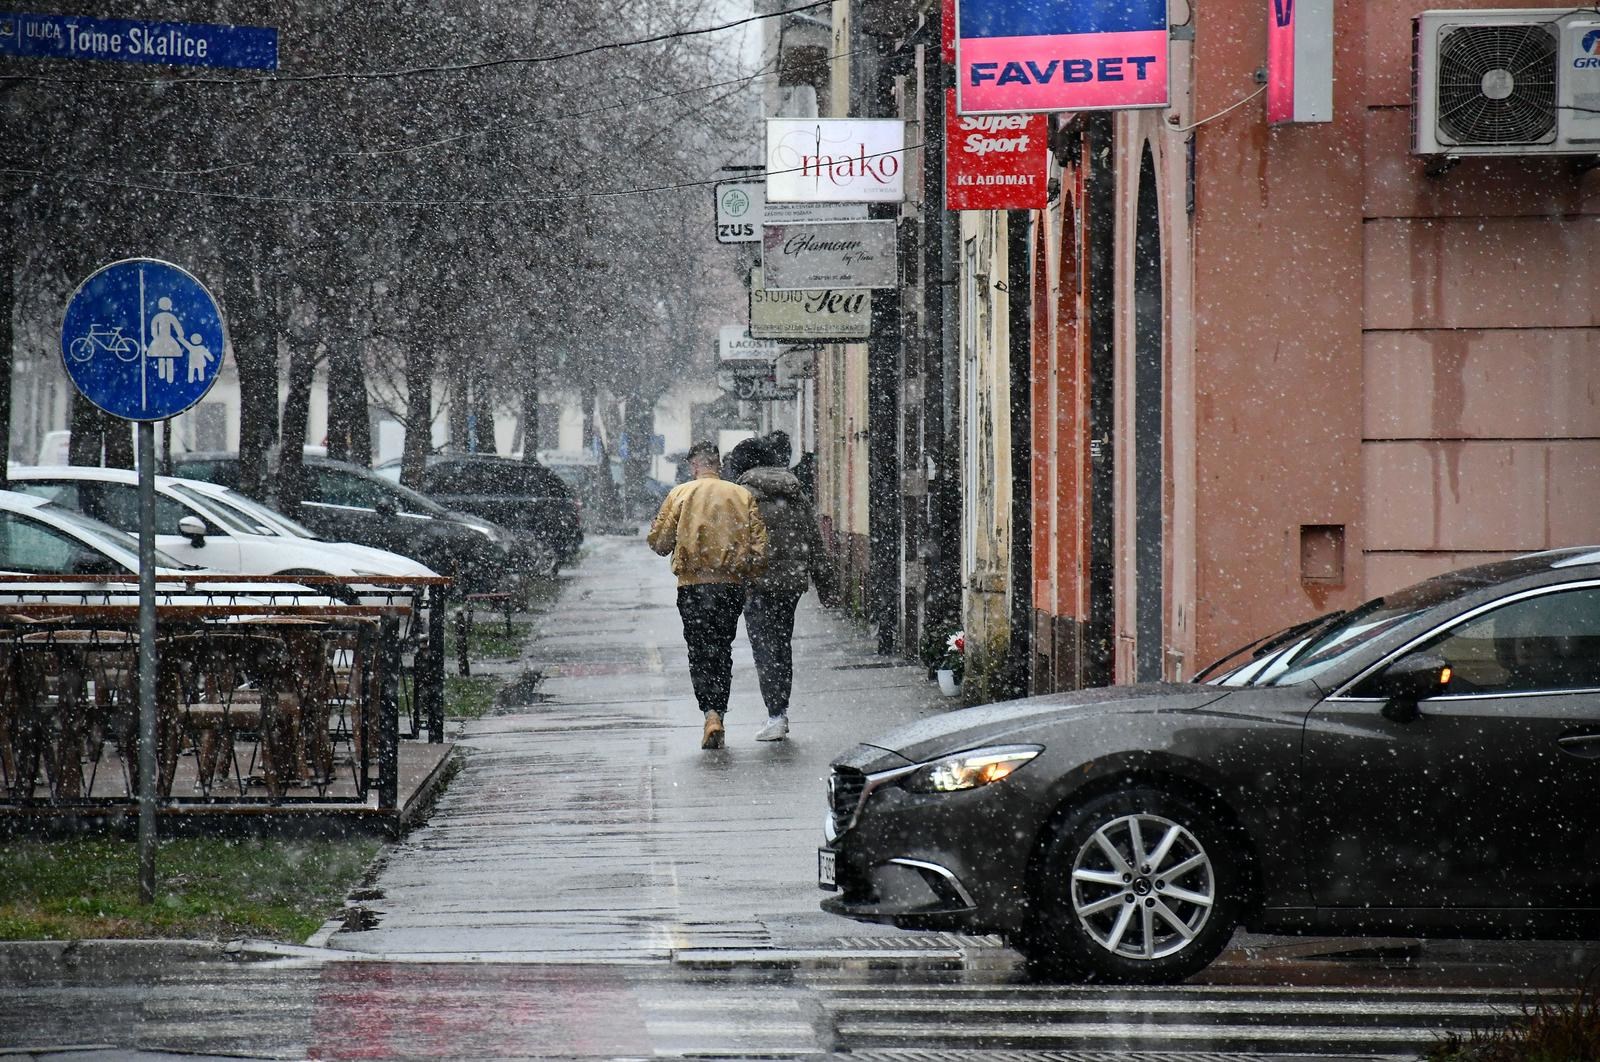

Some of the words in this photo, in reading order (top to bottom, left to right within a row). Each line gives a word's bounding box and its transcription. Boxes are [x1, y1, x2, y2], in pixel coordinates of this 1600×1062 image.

[26, 22, 61, 39] ULICA
[66, 24, 122, 53] Tome
[128, 28, 208, 58] Skalice
[970, 56, 1156, 87] FAVBET
[1573, 57, 1600, 69] GR
[960, 115, 1033, 134] Super
[963, 134, 1030, 156] Sport
[800, 143, 899, 186] mako
[957, 174, 1035, 186] KLADOMAT
[718, 223, 755, 237] ZUS
[784, 233, 862, 258] Glamour
[755, 289, 803, 303] STUDIO
[729, 340, 775, 349] LACOSTE
